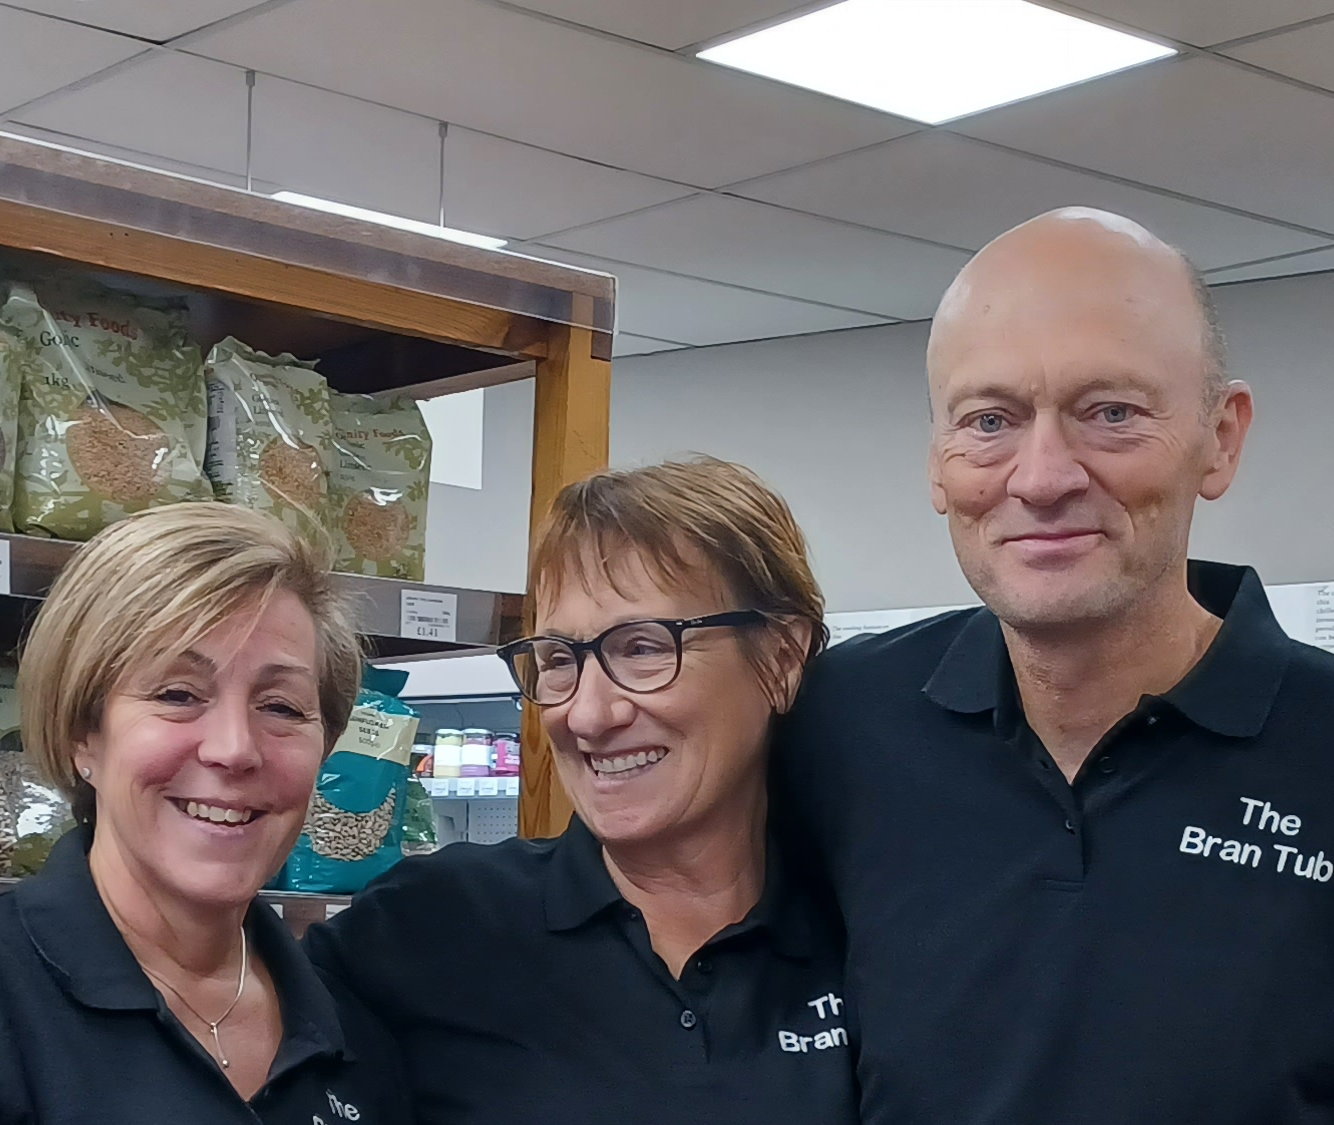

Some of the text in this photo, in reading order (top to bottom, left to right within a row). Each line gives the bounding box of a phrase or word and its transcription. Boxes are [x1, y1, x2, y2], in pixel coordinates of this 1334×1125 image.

[44, 372, 69, 390] 1kg
[416, 626, 438, 638] £1.41
[1239, 796, 1302, 836] The
[1179, 825, 1334, 882] Bran Tub
[778, 1027, 848, 1053] Bran
